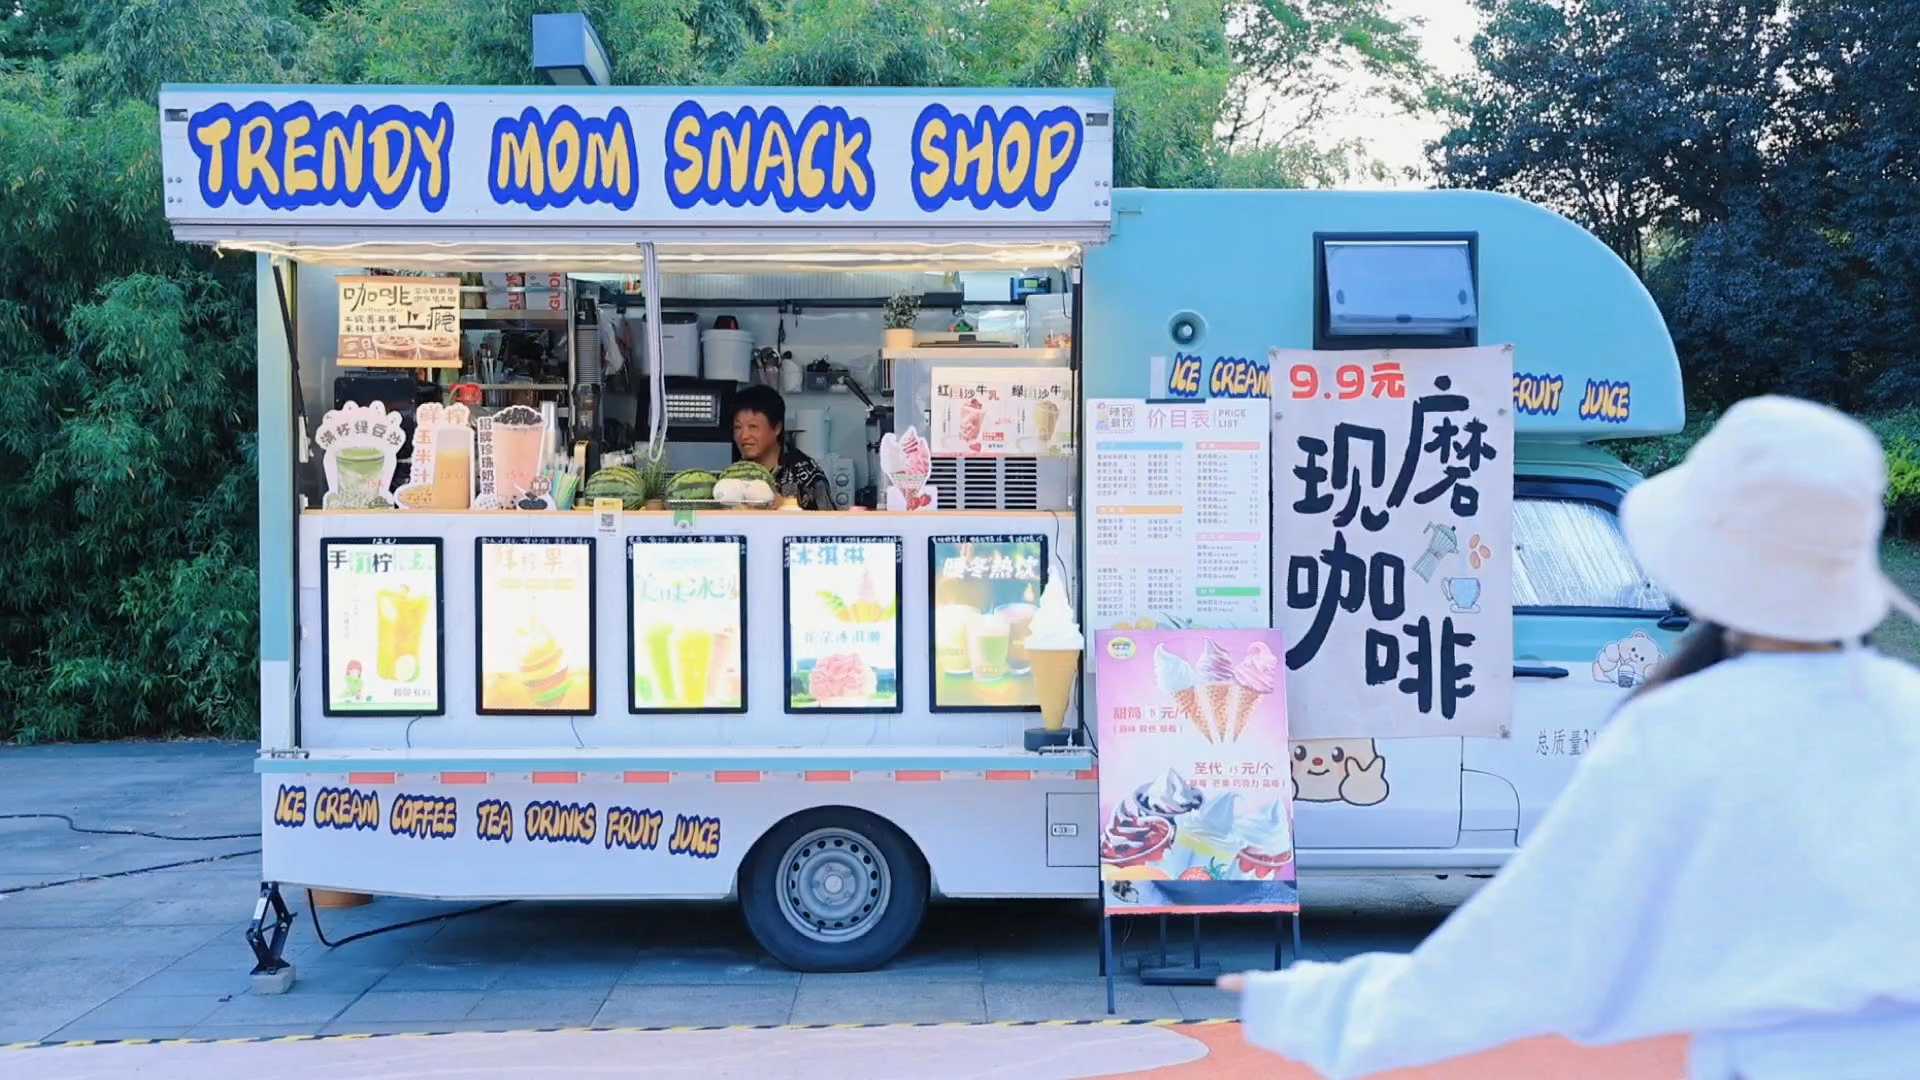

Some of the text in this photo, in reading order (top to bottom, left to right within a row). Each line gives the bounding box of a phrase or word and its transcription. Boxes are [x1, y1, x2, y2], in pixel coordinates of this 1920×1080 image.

[191, 104, 1080, 208] TRENDY MOM SNACK SHOP
[343, 283, 413, 312] 咖啡
[1169, 353, 1201, 396] ICE
[1289, 362, 1406, 400] 9.9元
[1147, 408, 1210, 429] 价目表
[1218, 408, 1246, 417] PRICE
[1579, 379, 1630, 422] JUICE
[1218, 419, 1239, 428] LIST
[479, 417, 495, 496] 招牌珍珠奶茶
[1292, 375, 1497, 532] 现磨
[1285, 530, 1476, 720] 咖啡
[275, 785, 720, 858] ICE CREAM COFFEE TEA DRINKS FRUIT JUICE
